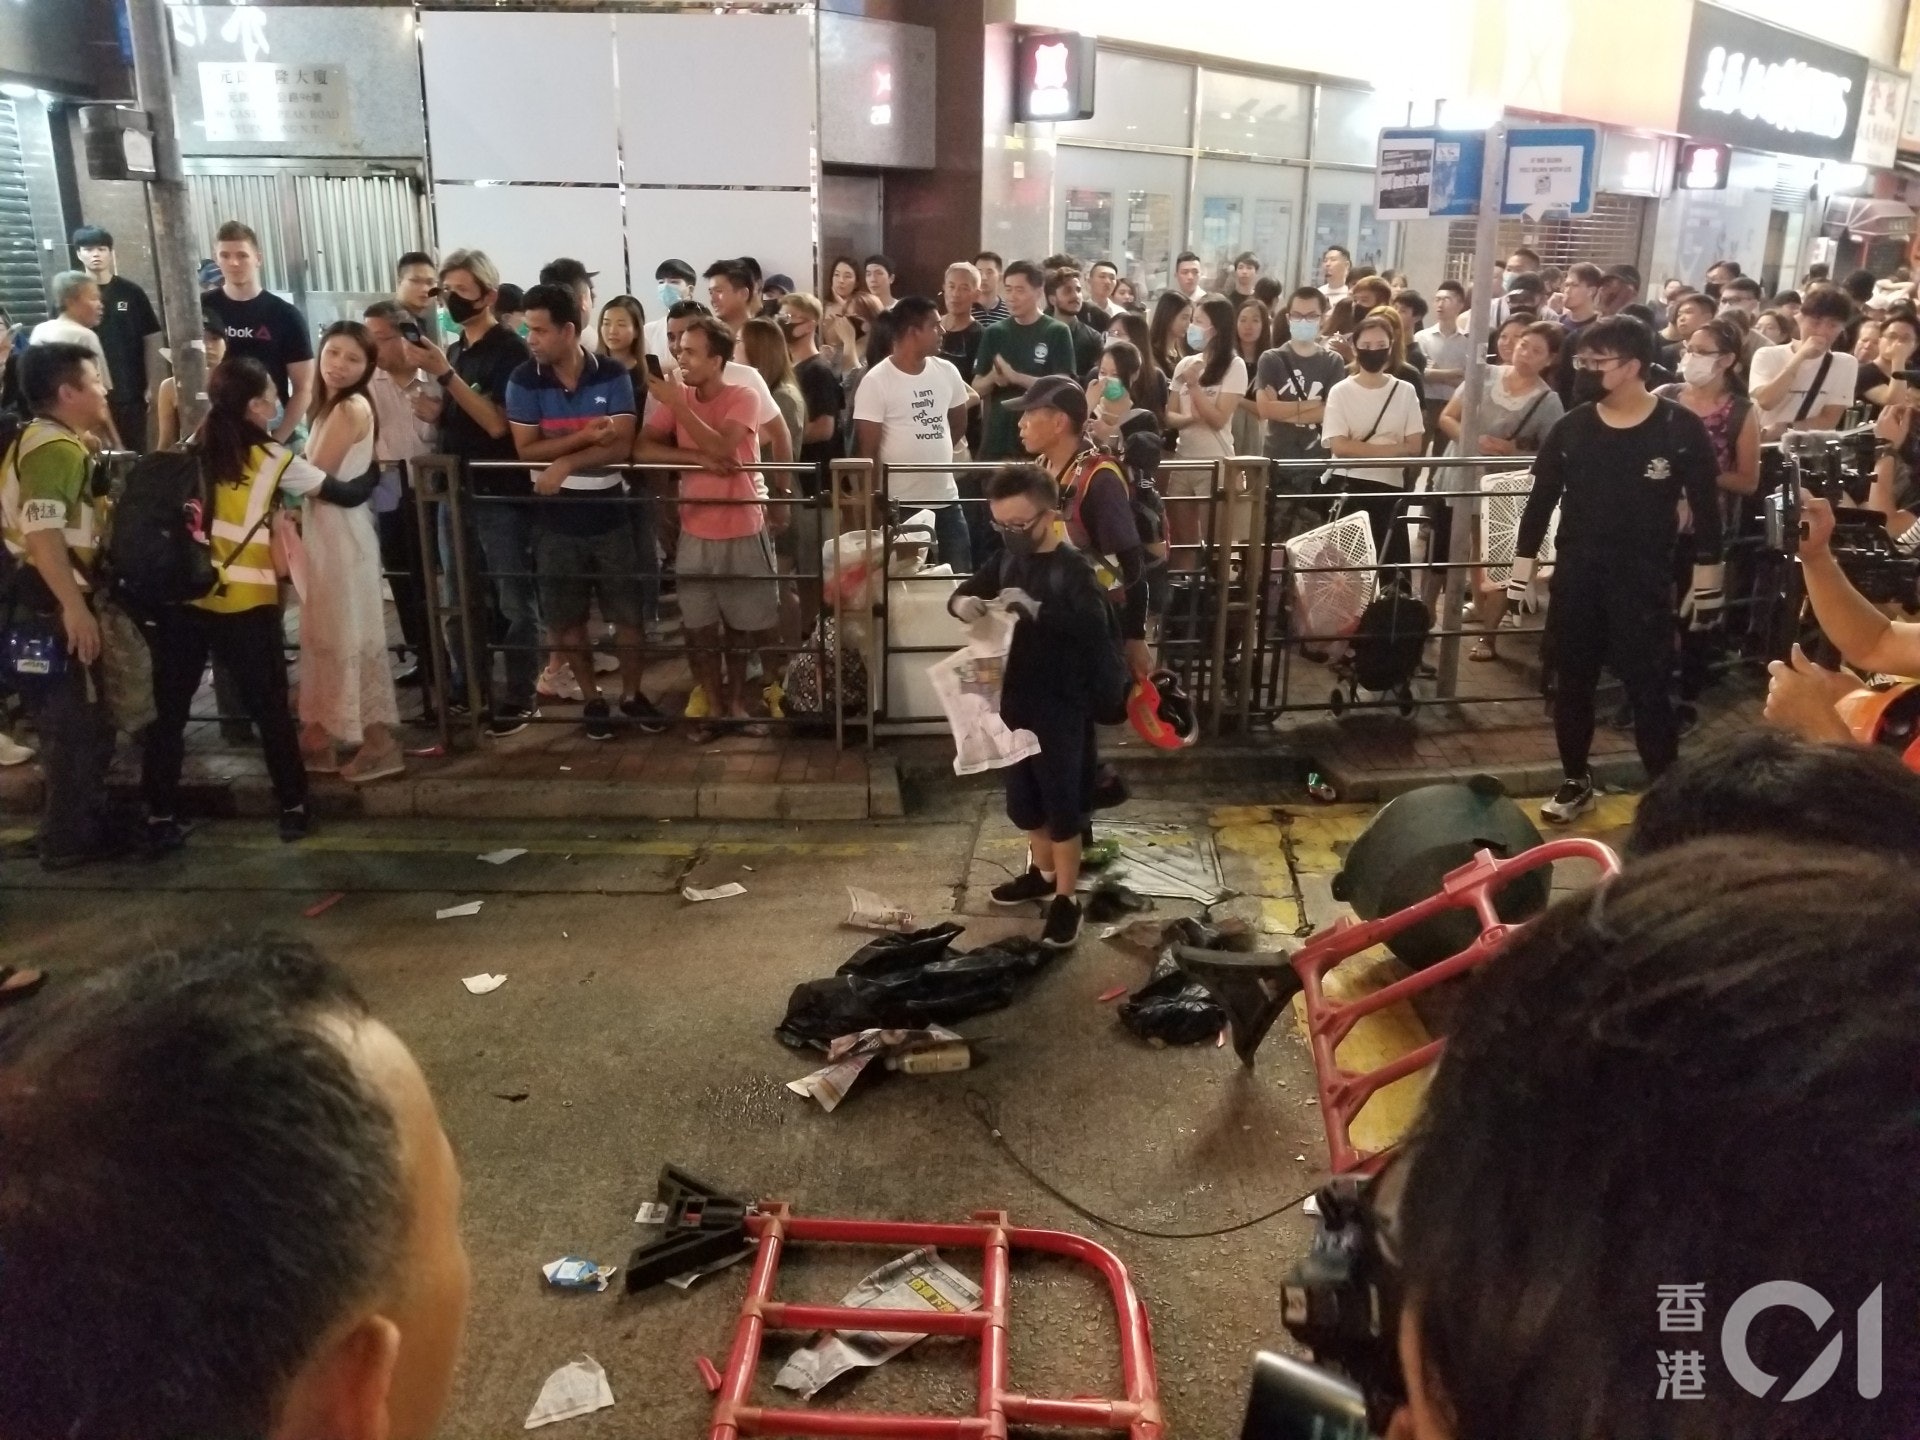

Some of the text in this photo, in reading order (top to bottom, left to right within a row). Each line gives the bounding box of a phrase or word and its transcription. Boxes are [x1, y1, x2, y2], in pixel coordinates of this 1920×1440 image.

[309, 109, 340, 119] ROAD
[913, 389, 933, 398] I am
[911, 399, 934, 408] really
[912, 409, 928, 422] not
[920, 414, 943, 426] good
[915, 431, 944, 439] words
